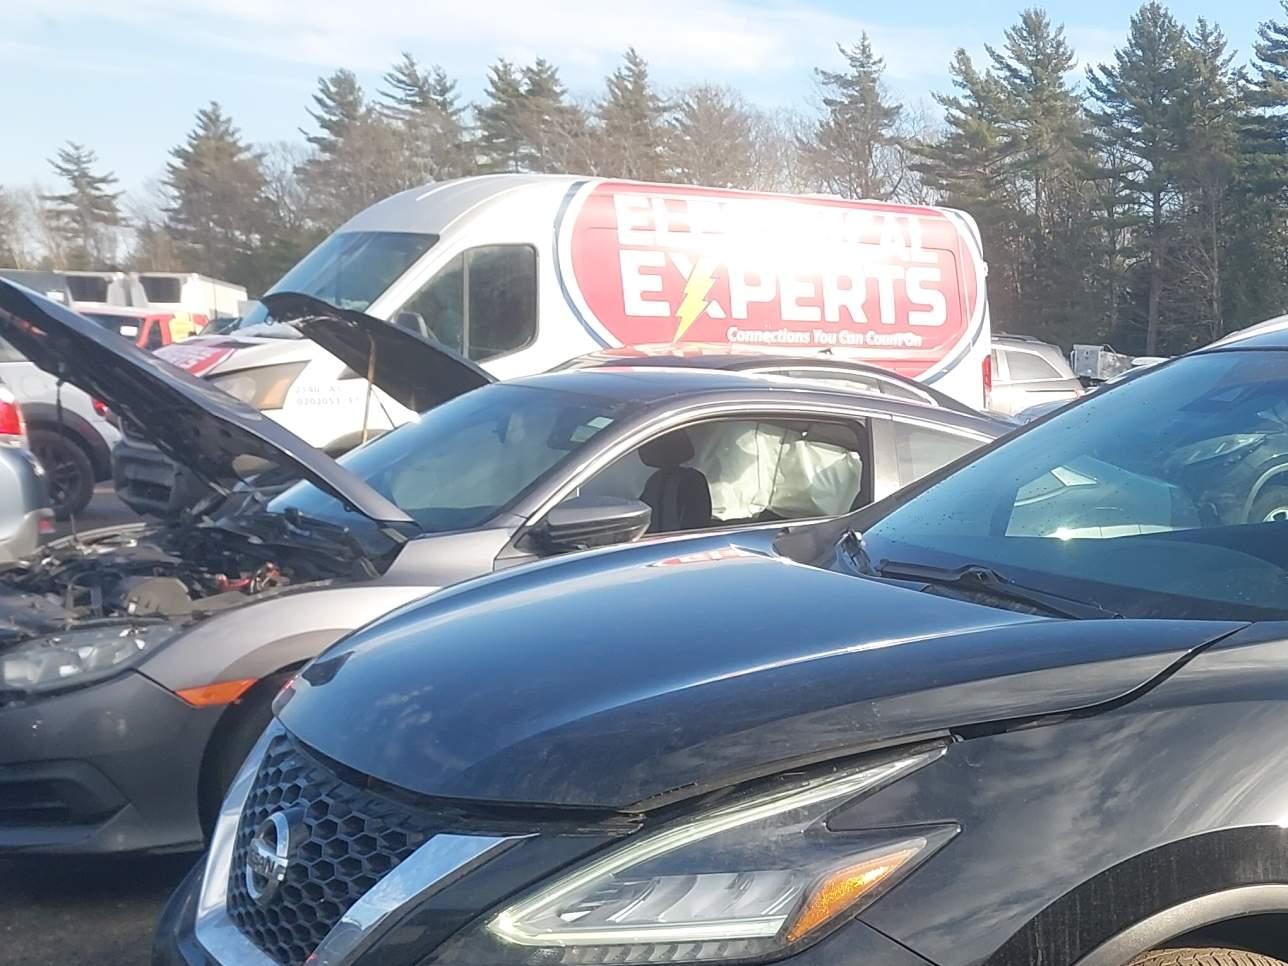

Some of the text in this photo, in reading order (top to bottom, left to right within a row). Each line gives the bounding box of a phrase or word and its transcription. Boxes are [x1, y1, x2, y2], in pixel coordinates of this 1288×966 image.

[618, 249, 948, 327] EXPERTS
[727, 326, 811, 344] Connections
[812, 329, 837, 344] You
[838, 330, 864, 345] Can
